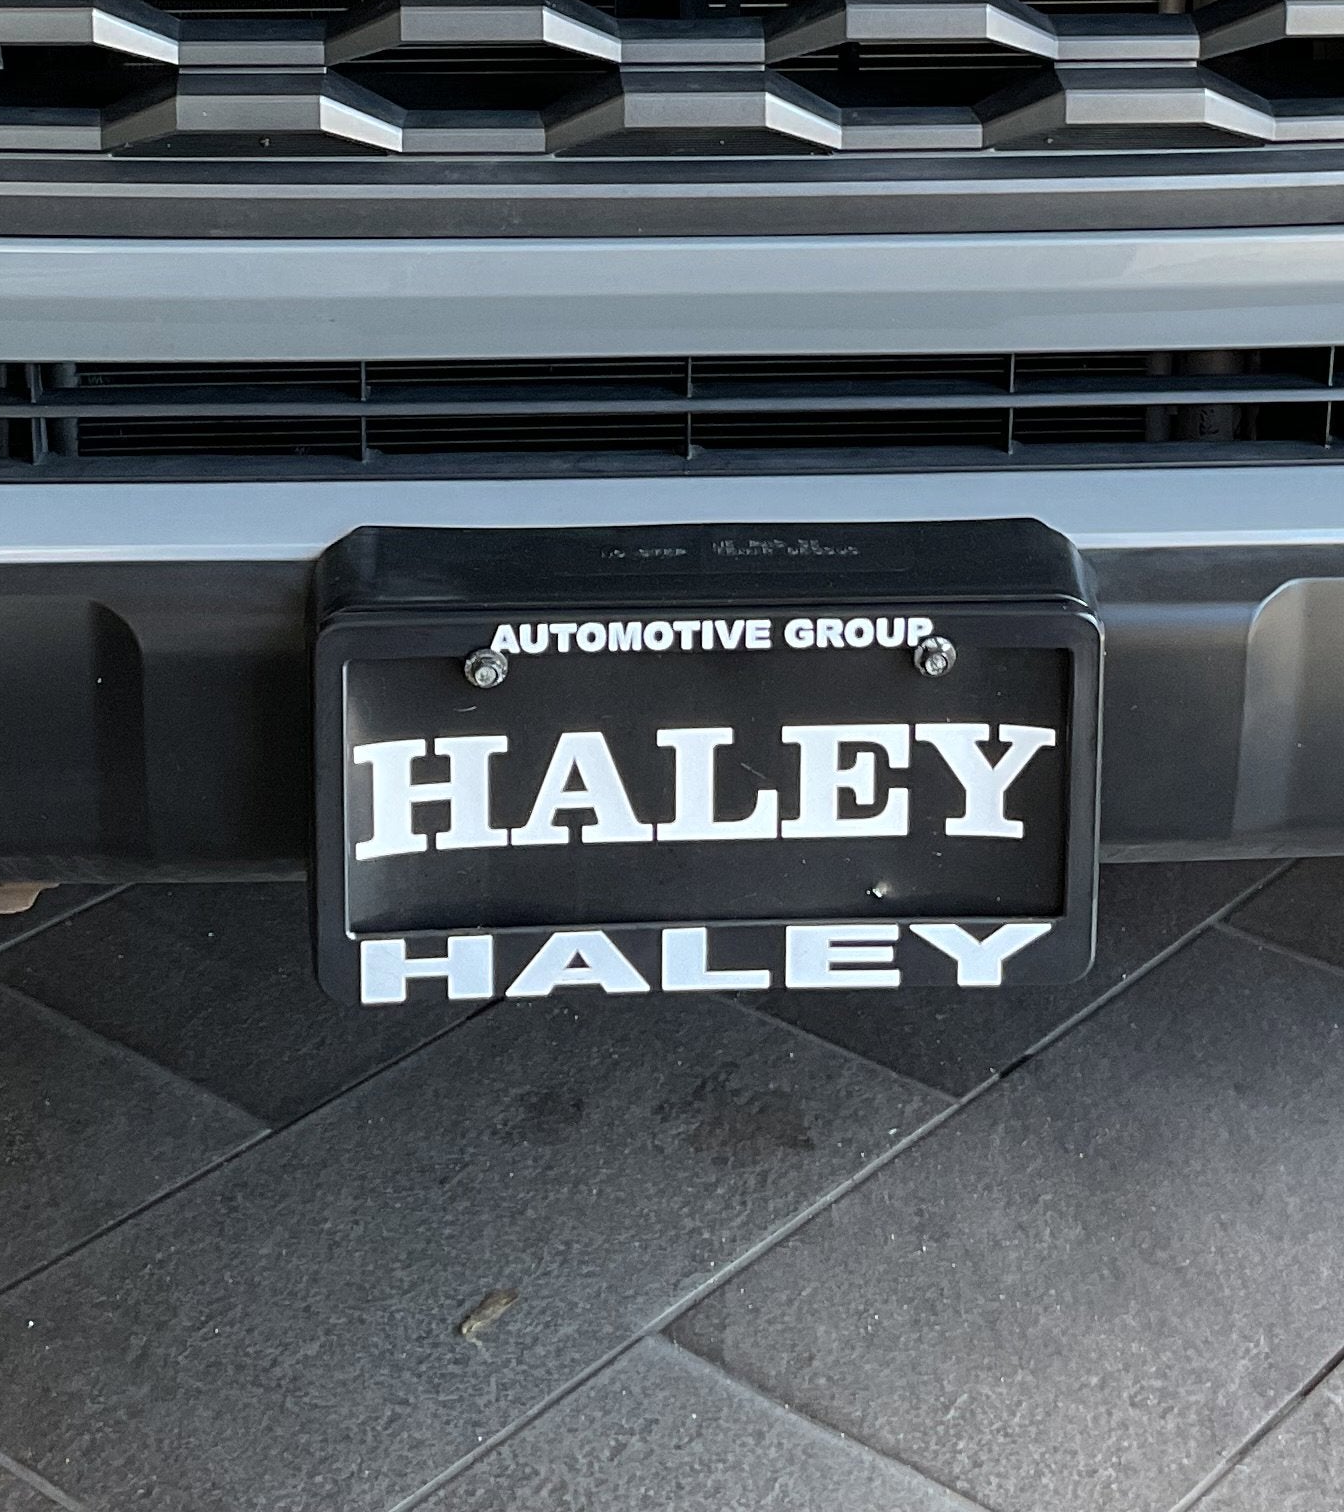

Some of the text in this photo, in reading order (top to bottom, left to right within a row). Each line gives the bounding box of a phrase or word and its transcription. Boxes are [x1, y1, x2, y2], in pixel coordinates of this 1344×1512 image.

[491, 617, 934, 655] AUTOMOTIVE GROUP
[353, 722, 1056, 861] HALEY
[359, 922, 1053, 1005] HALEY
